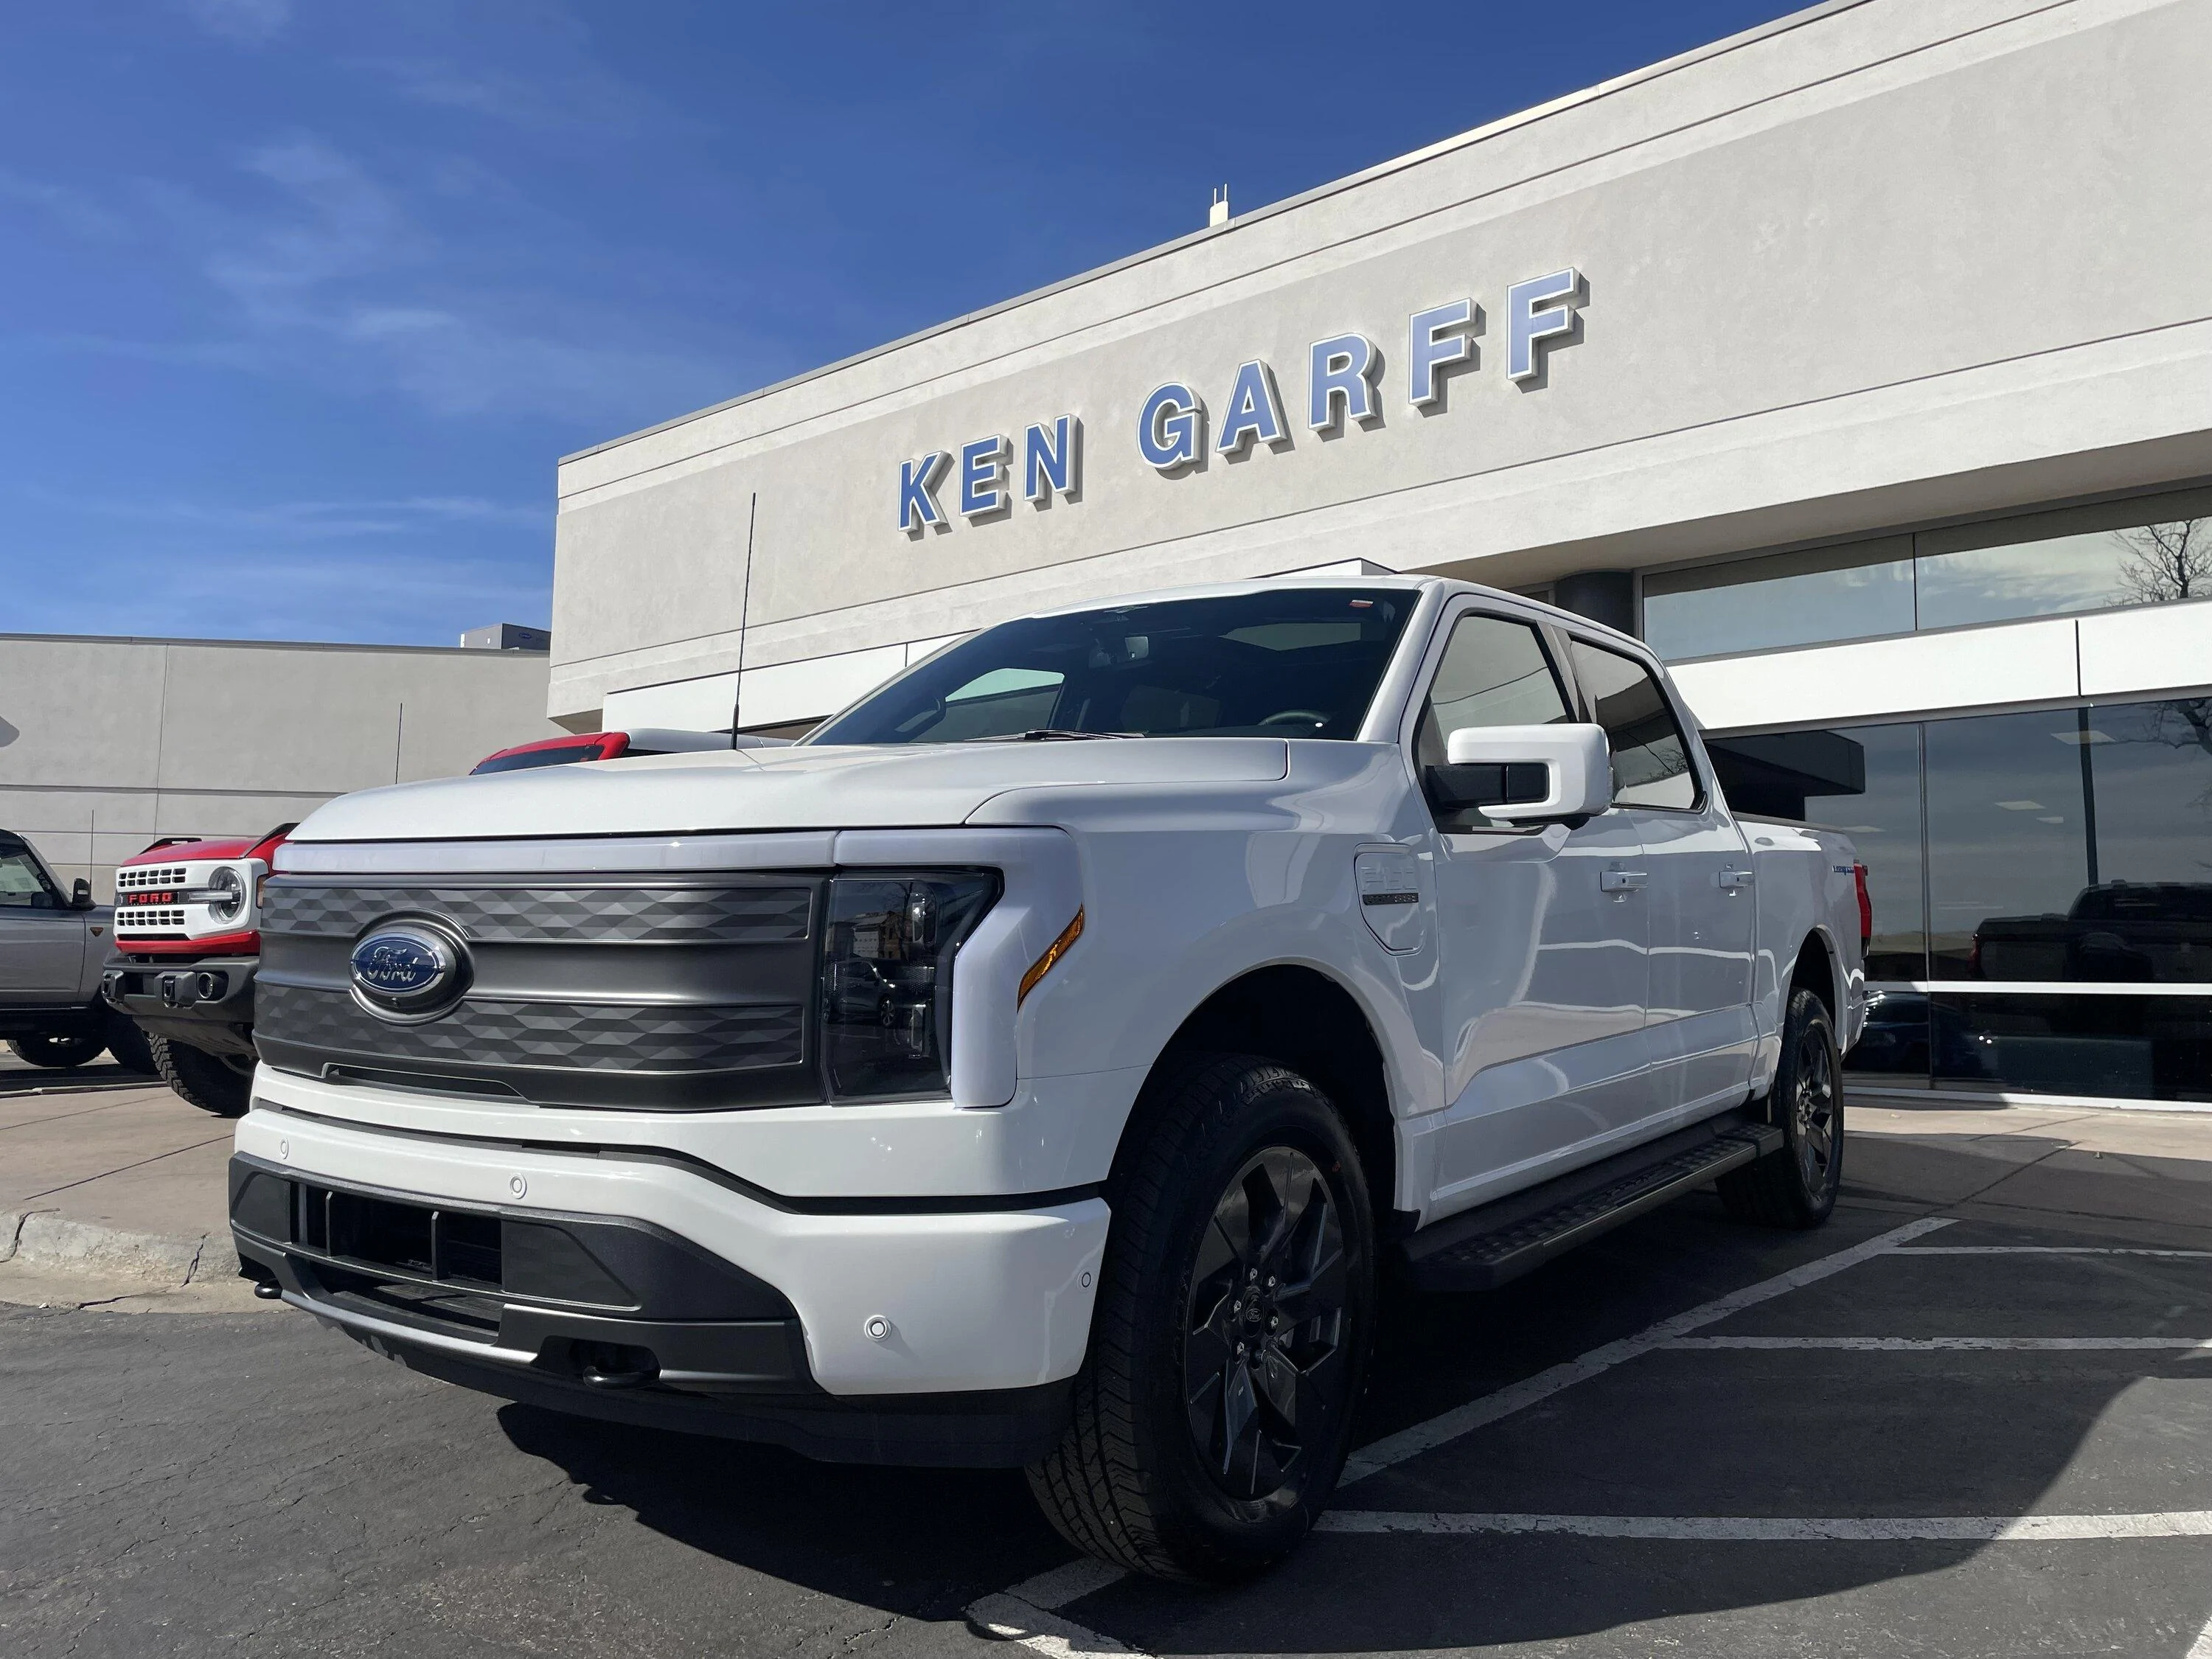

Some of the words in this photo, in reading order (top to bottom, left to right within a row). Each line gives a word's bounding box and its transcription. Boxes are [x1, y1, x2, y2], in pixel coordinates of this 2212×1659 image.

[898, 414, 1079, 532] KEN
[1137, 266, 1578, 470] GARFF
[129, 892, 171, 903] FORD
[367, 946, 418, 982] Ford
